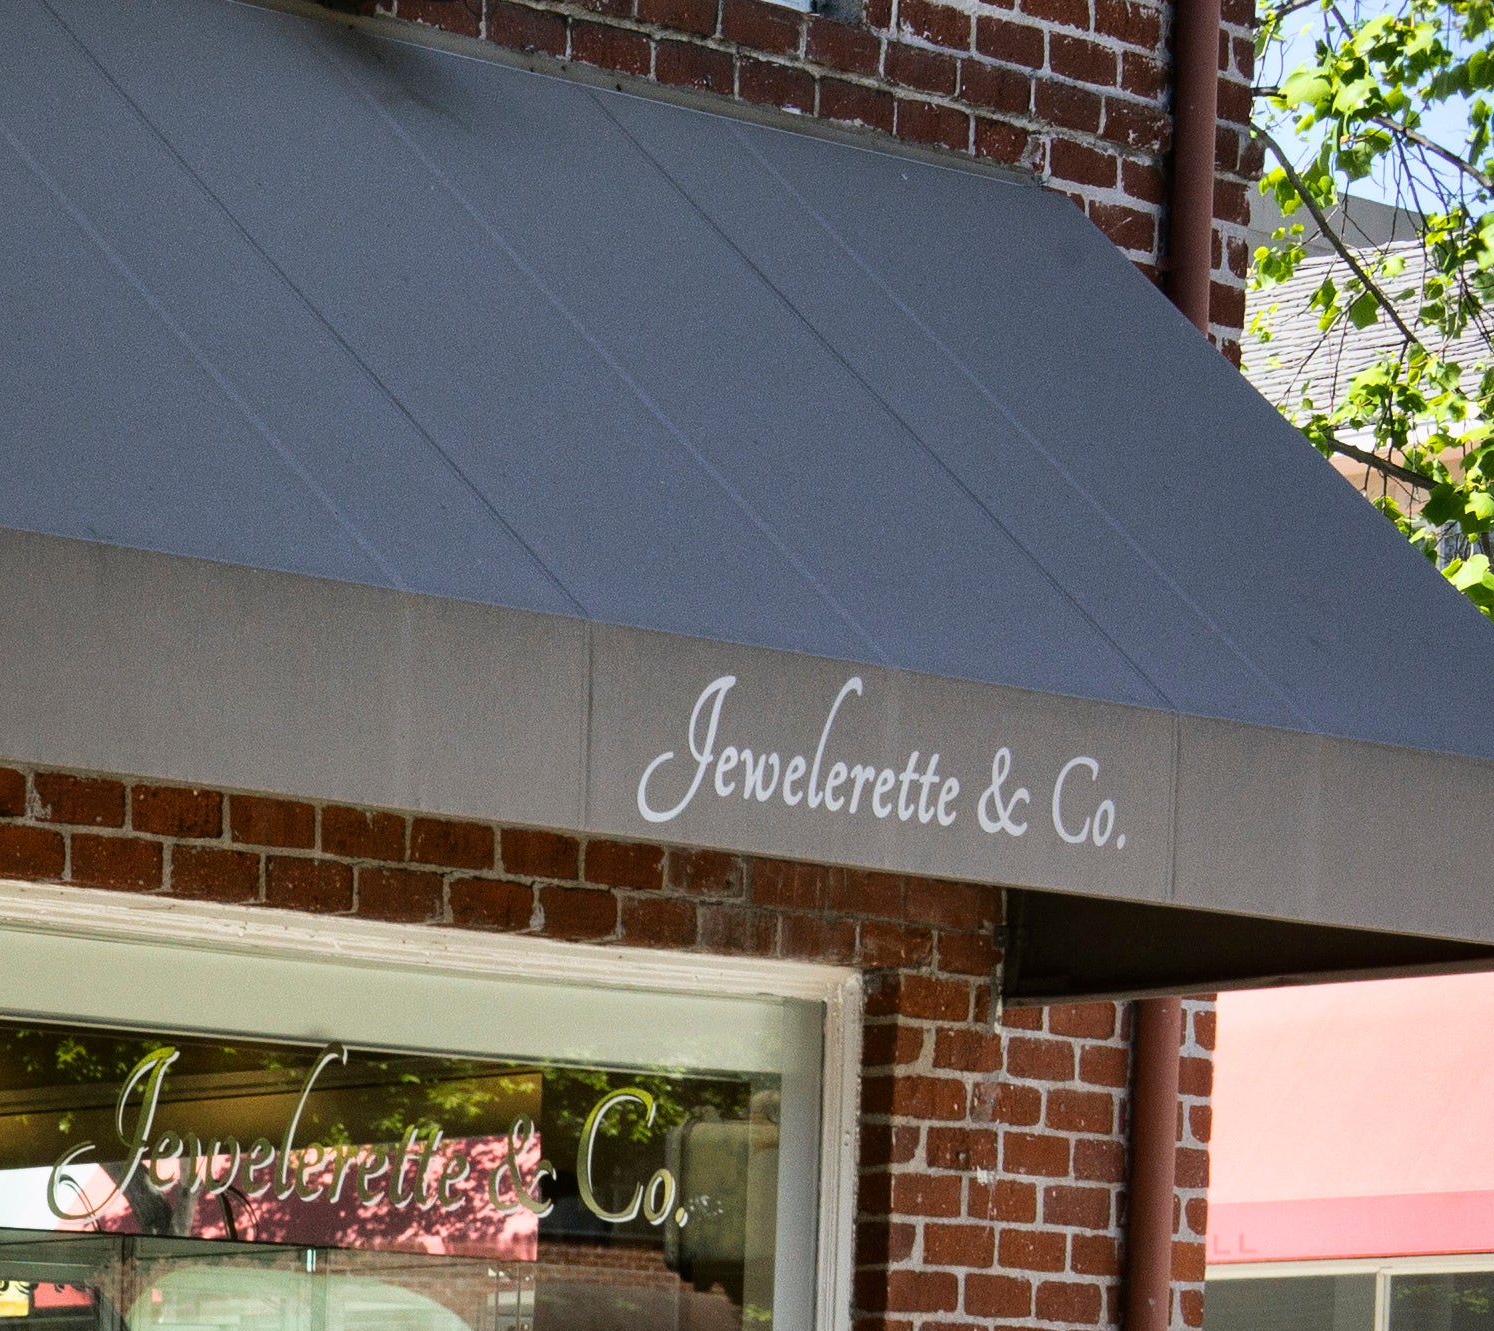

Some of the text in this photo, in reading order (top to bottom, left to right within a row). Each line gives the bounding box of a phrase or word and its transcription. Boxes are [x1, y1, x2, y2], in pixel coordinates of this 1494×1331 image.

[637, 675, 1127, 851] Jewelerette & Co.
[47, 1041, 691, 1228] Jewelerette & Co.
